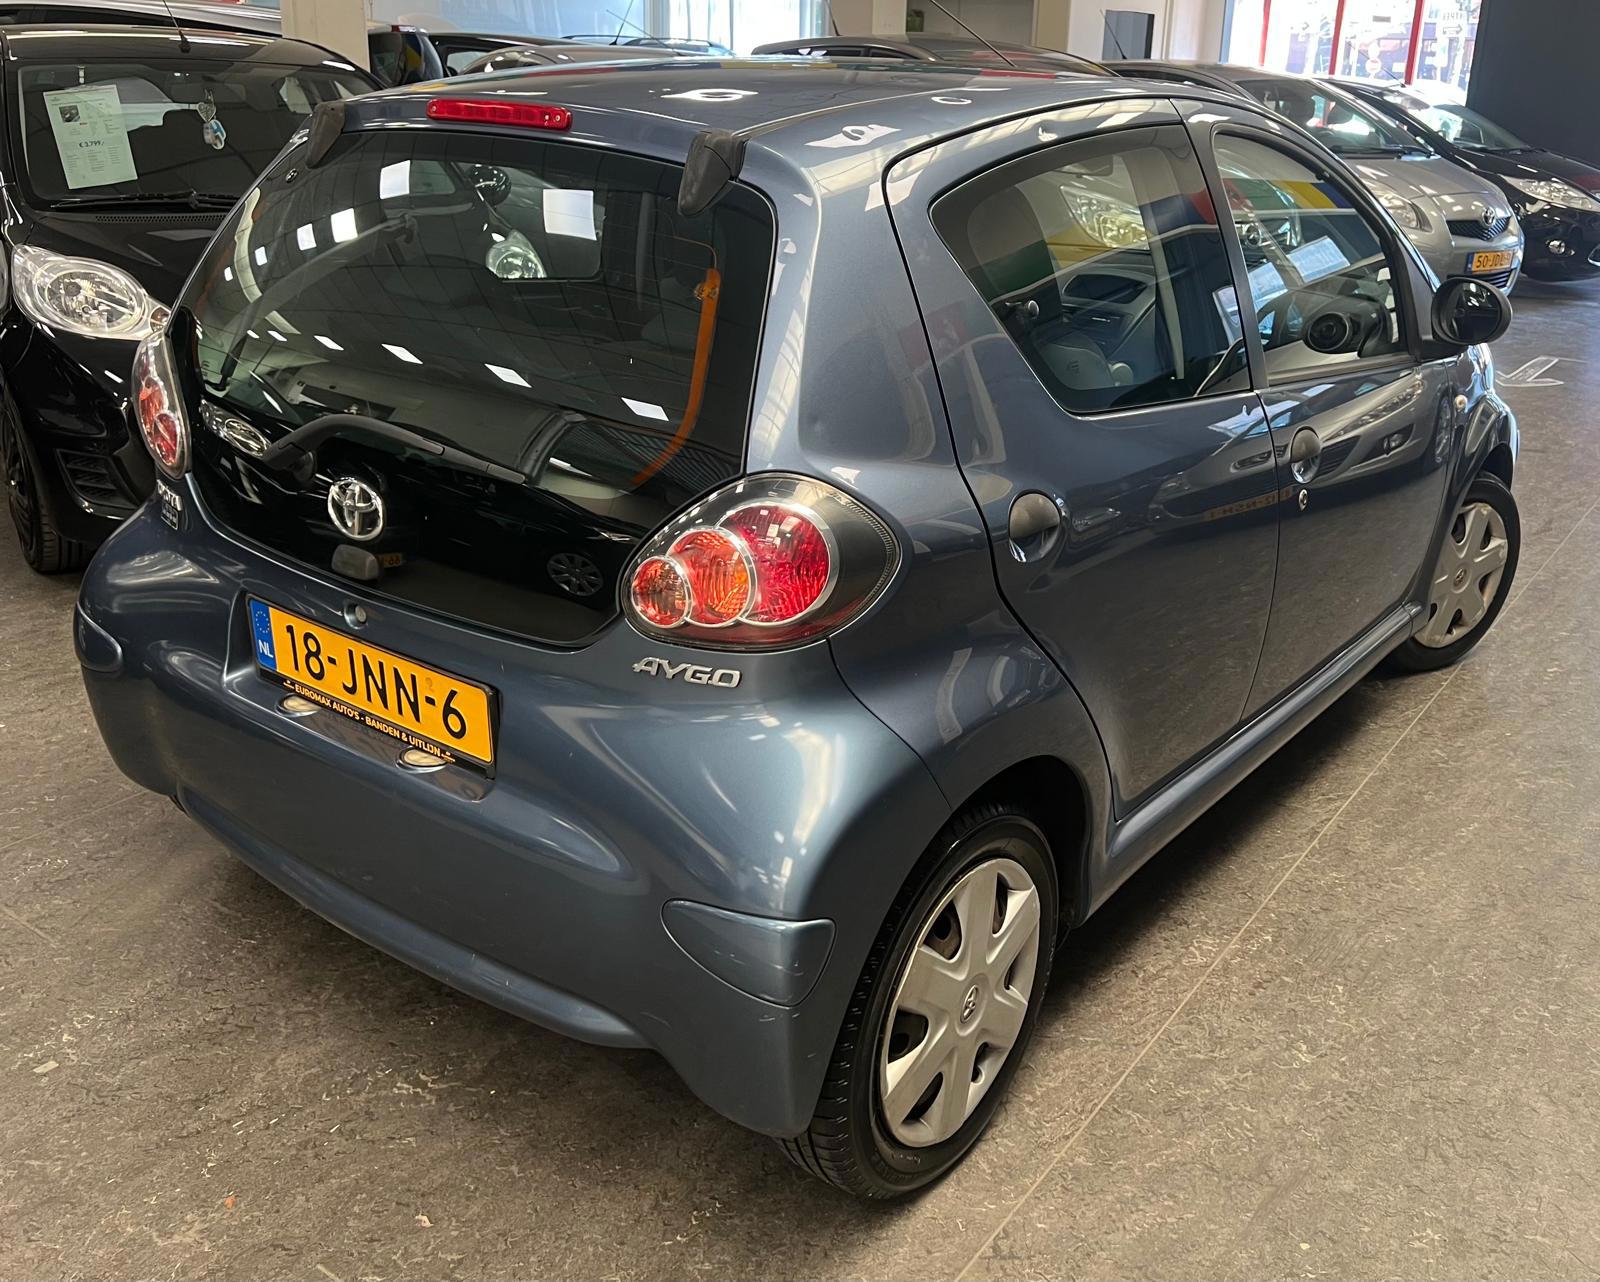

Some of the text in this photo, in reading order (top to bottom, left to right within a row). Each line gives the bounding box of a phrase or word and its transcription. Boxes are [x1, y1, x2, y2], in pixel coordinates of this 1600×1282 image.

[259, 639, 274, 658] NL
[632, 656, 742, 688] AYGO
[286, 624, 468, 740] 18-JNN-6
[294, 684, 332, 708] EUROMAX
[332, 701, 360, 721] AUTO'S
[365, 716, 401, 739] BANDEN
[401, 732, 408, 742] &
[408, 734, 441, 757] UITLIJN
